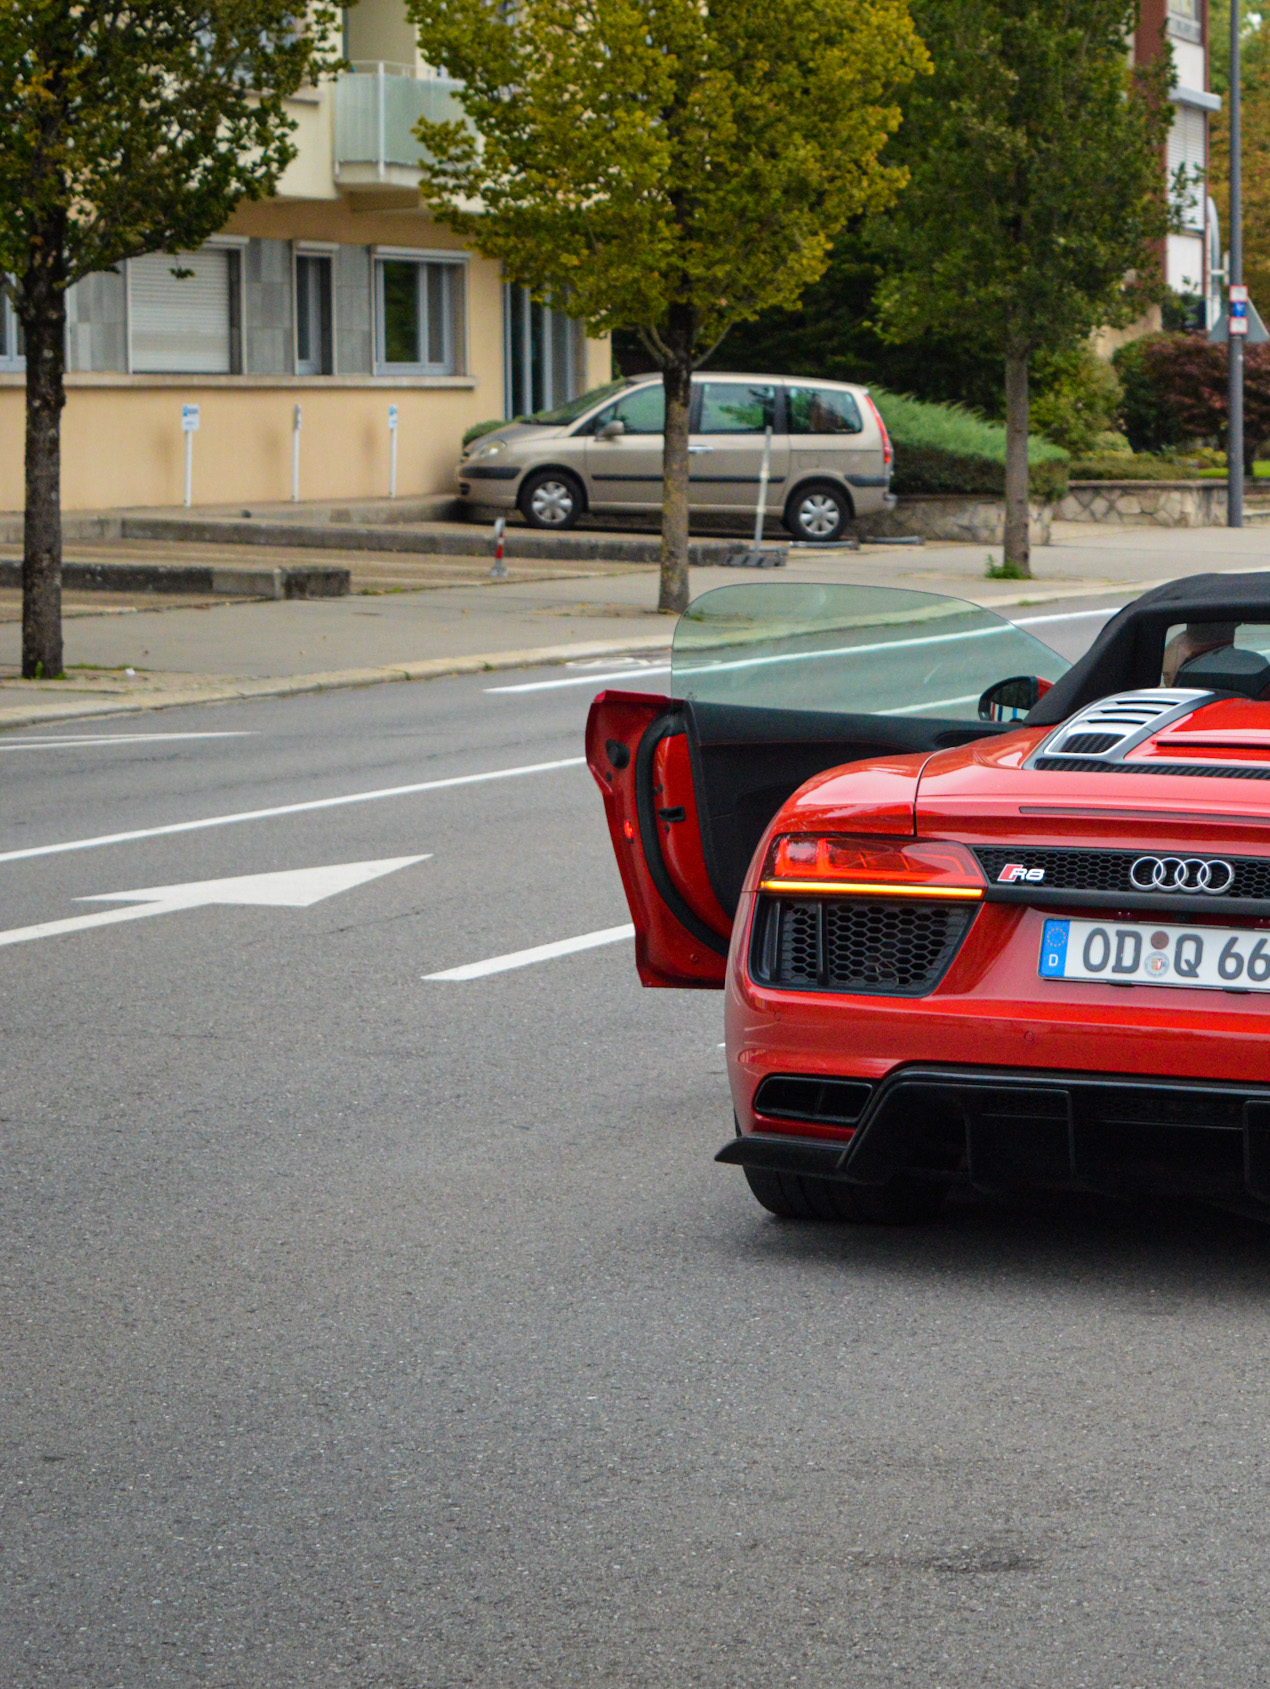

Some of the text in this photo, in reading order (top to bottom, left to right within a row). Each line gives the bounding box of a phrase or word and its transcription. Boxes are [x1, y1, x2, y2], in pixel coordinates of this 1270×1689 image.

[1001, 865, 1046, 882] R8
[1048, 954, 1059, 967] D
[1083, 927, 1143, 974] OD
[1173, 933, 1204, 978] Q
